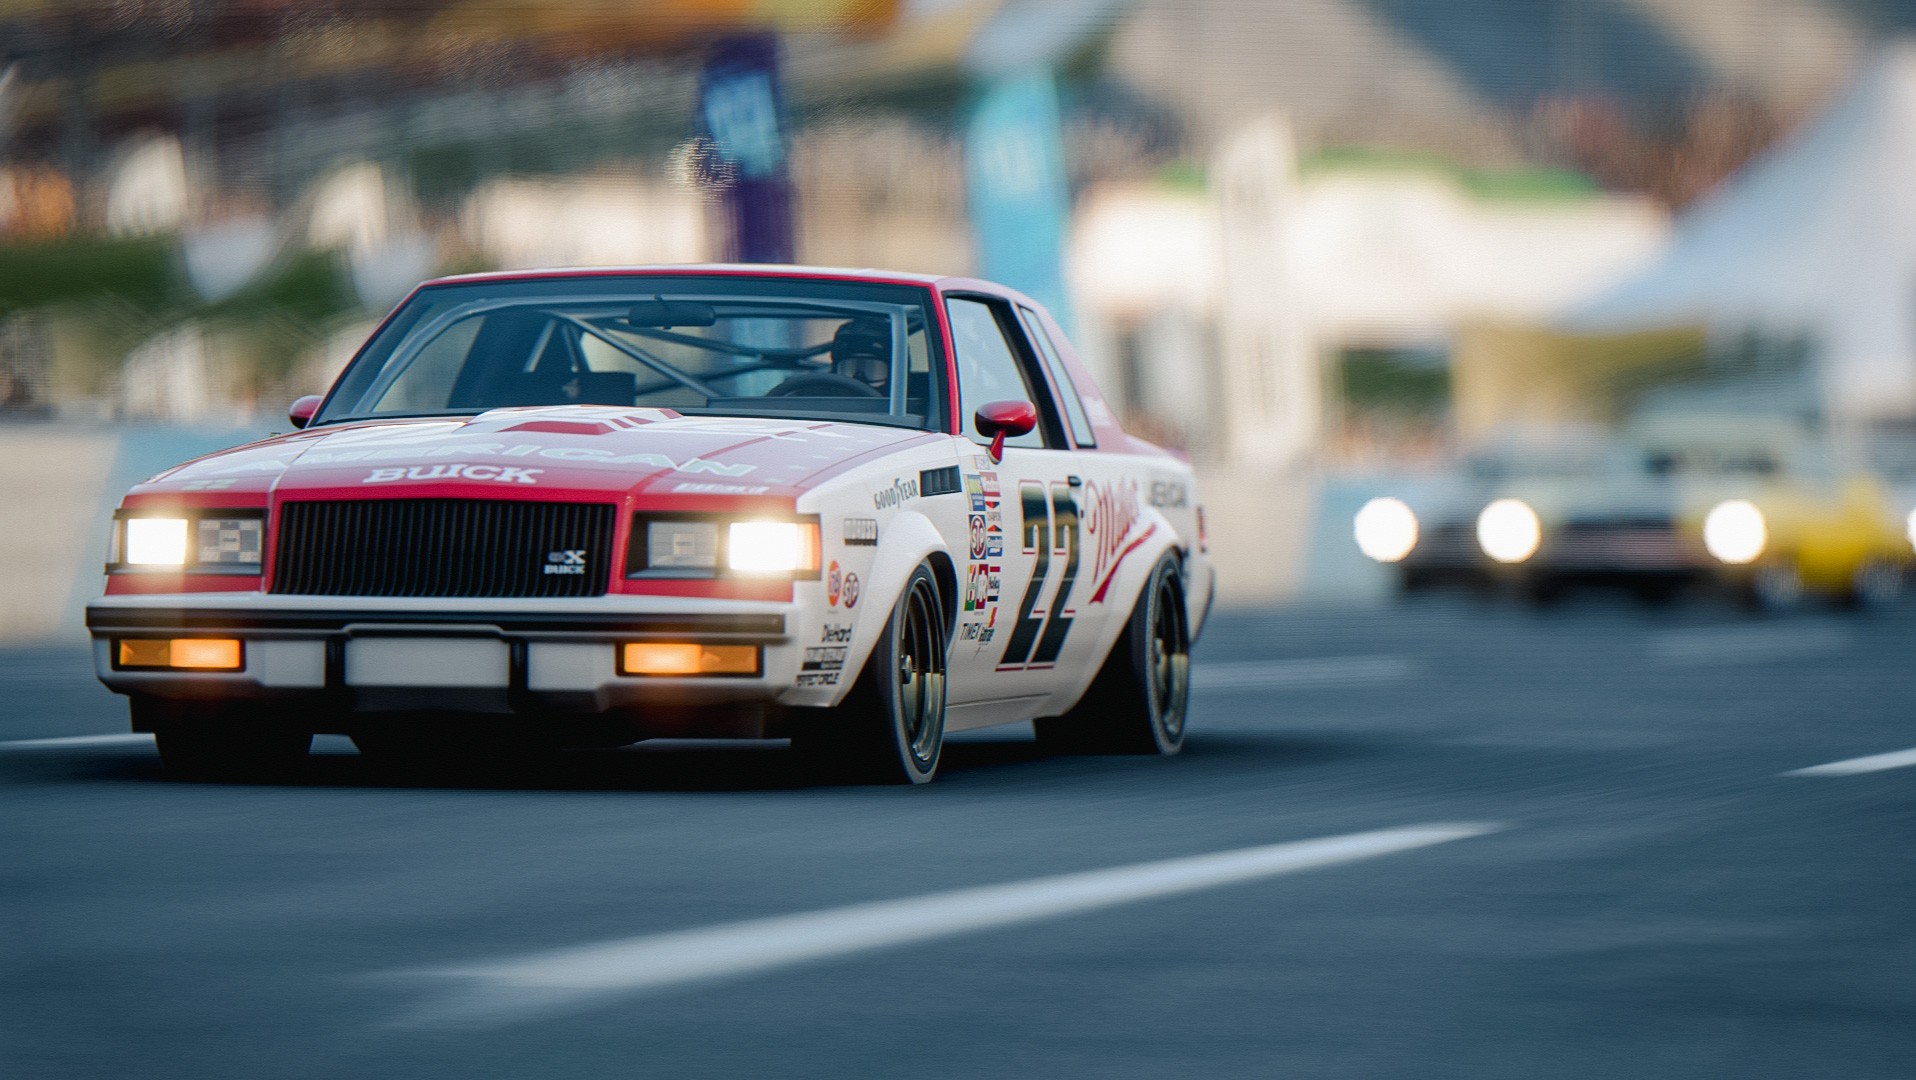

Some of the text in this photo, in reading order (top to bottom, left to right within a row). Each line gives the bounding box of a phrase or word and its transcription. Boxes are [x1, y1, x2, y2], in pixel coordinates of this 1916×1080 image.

[362, 463, 545, 484] BUICK
[873, 477, 919, 511] GOODYEAR
[543, 564, 586, 575] BUICK
[996, 479, 1081, 673] 22
